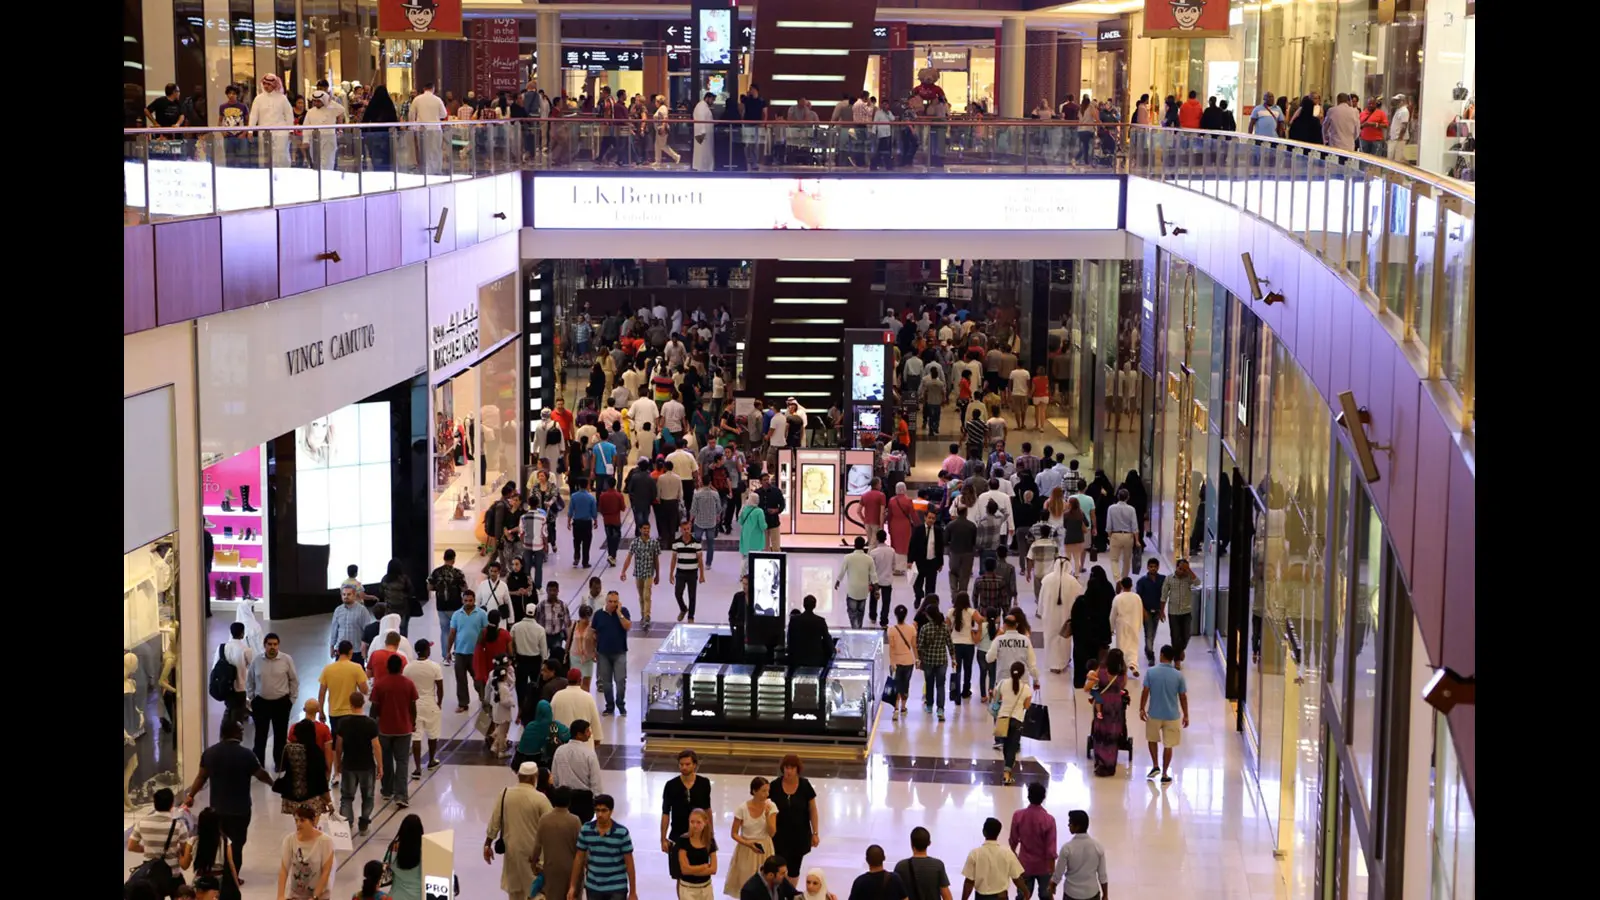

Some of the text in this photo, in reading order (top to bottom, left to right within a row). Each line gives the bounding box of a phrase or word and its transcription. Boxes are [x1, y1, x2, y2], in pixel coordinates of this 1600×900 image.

[285, 323, 375, 377] VINCE CAMUTO
[998, 638, 1029, 649] MCML
[425, 882, 449, 894] PRO
